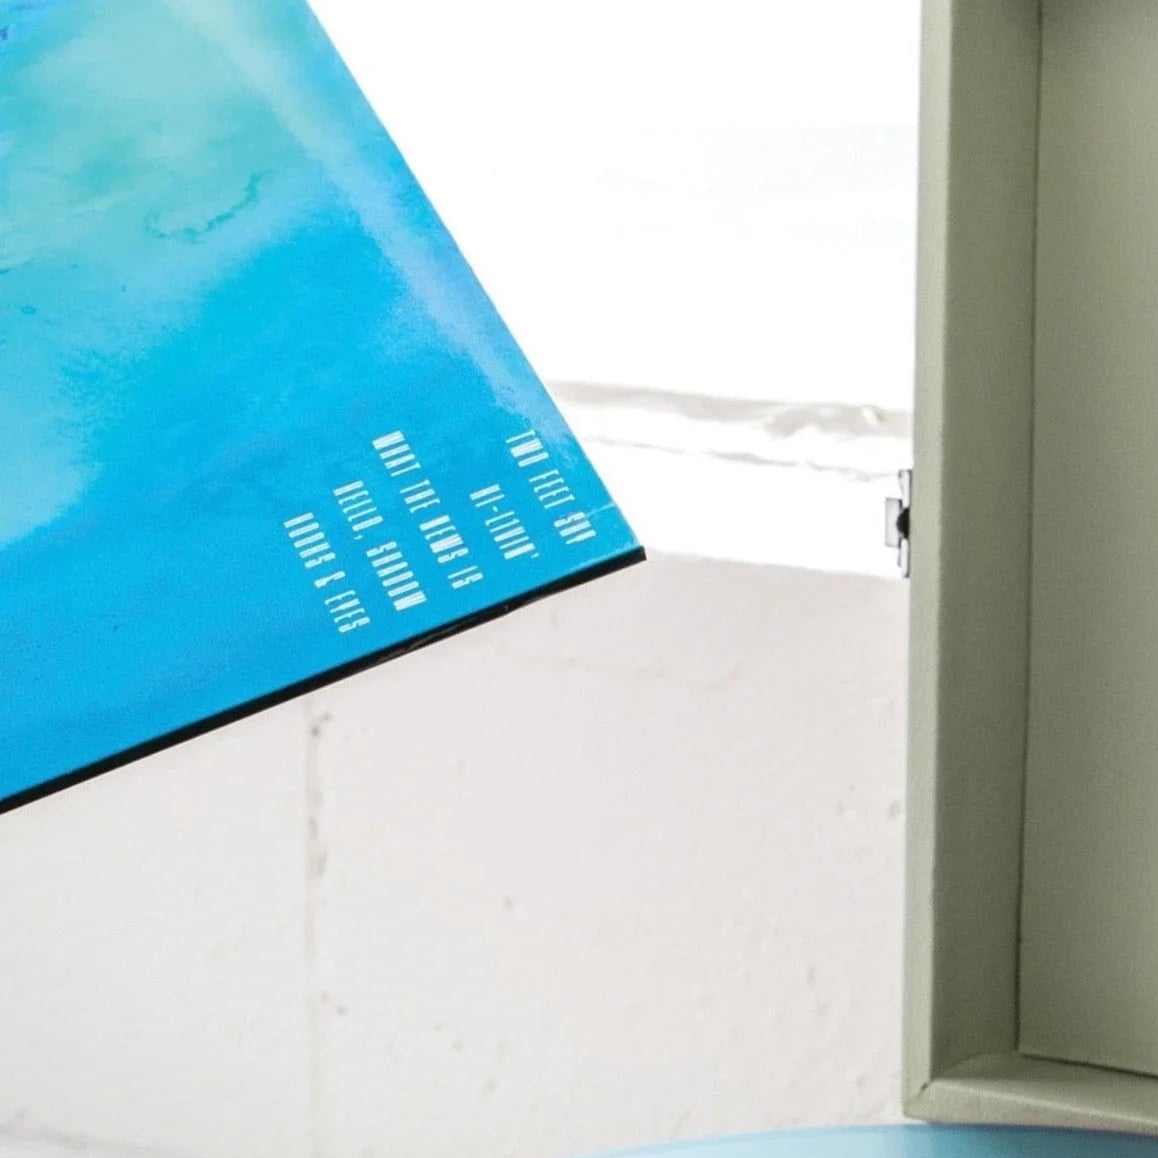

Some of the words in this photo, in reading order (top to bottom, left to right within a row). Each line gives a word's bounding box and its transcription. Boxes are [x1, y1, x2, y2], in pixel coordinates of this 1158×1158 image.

[372, 430, 421, 477] WHAT
[505, 429, 549, 467] TWO
[529, 469, 575, 509] FEET
[400, 479, 440, 513] THE
[284, 512, 336, 568] HOOKS
[333, 480, 383, 540] HELLO,
[366, 541, 427, 611] SHADOW
[419, 515, 469, 563] NEWS
[314, 571, 346, 588] &
[448, 566, 484, 589] IS
[325, 590, 370, 633] EYES
